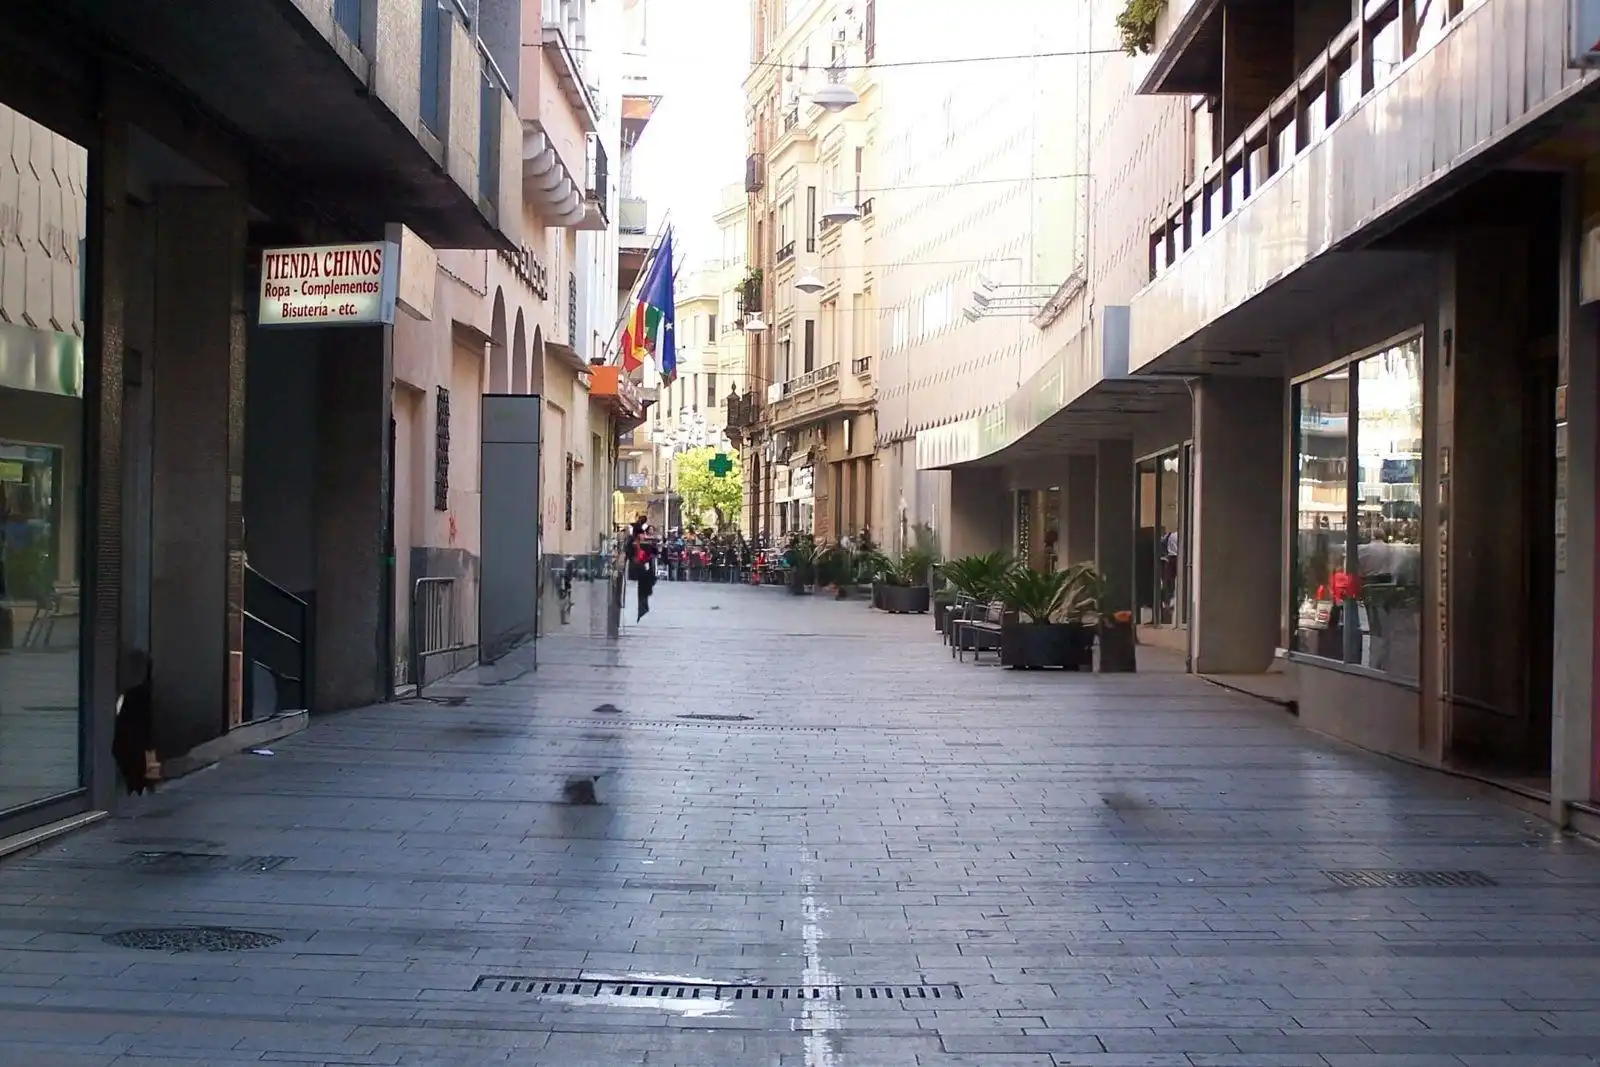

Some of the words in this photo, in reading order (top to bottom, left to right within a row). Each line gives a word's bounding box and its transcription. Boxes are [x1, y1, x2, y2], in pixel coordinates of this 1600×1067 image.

[266, 252, 319, 280] TIENDA
[324, 249, 382, 277] CHINOS
[265, 282, 290, 301] Ropa
[301, 279, 379, 299] Complementos
[282, 300, 328, 318] Bisutería
[339, 303, 358, 315] etc.
